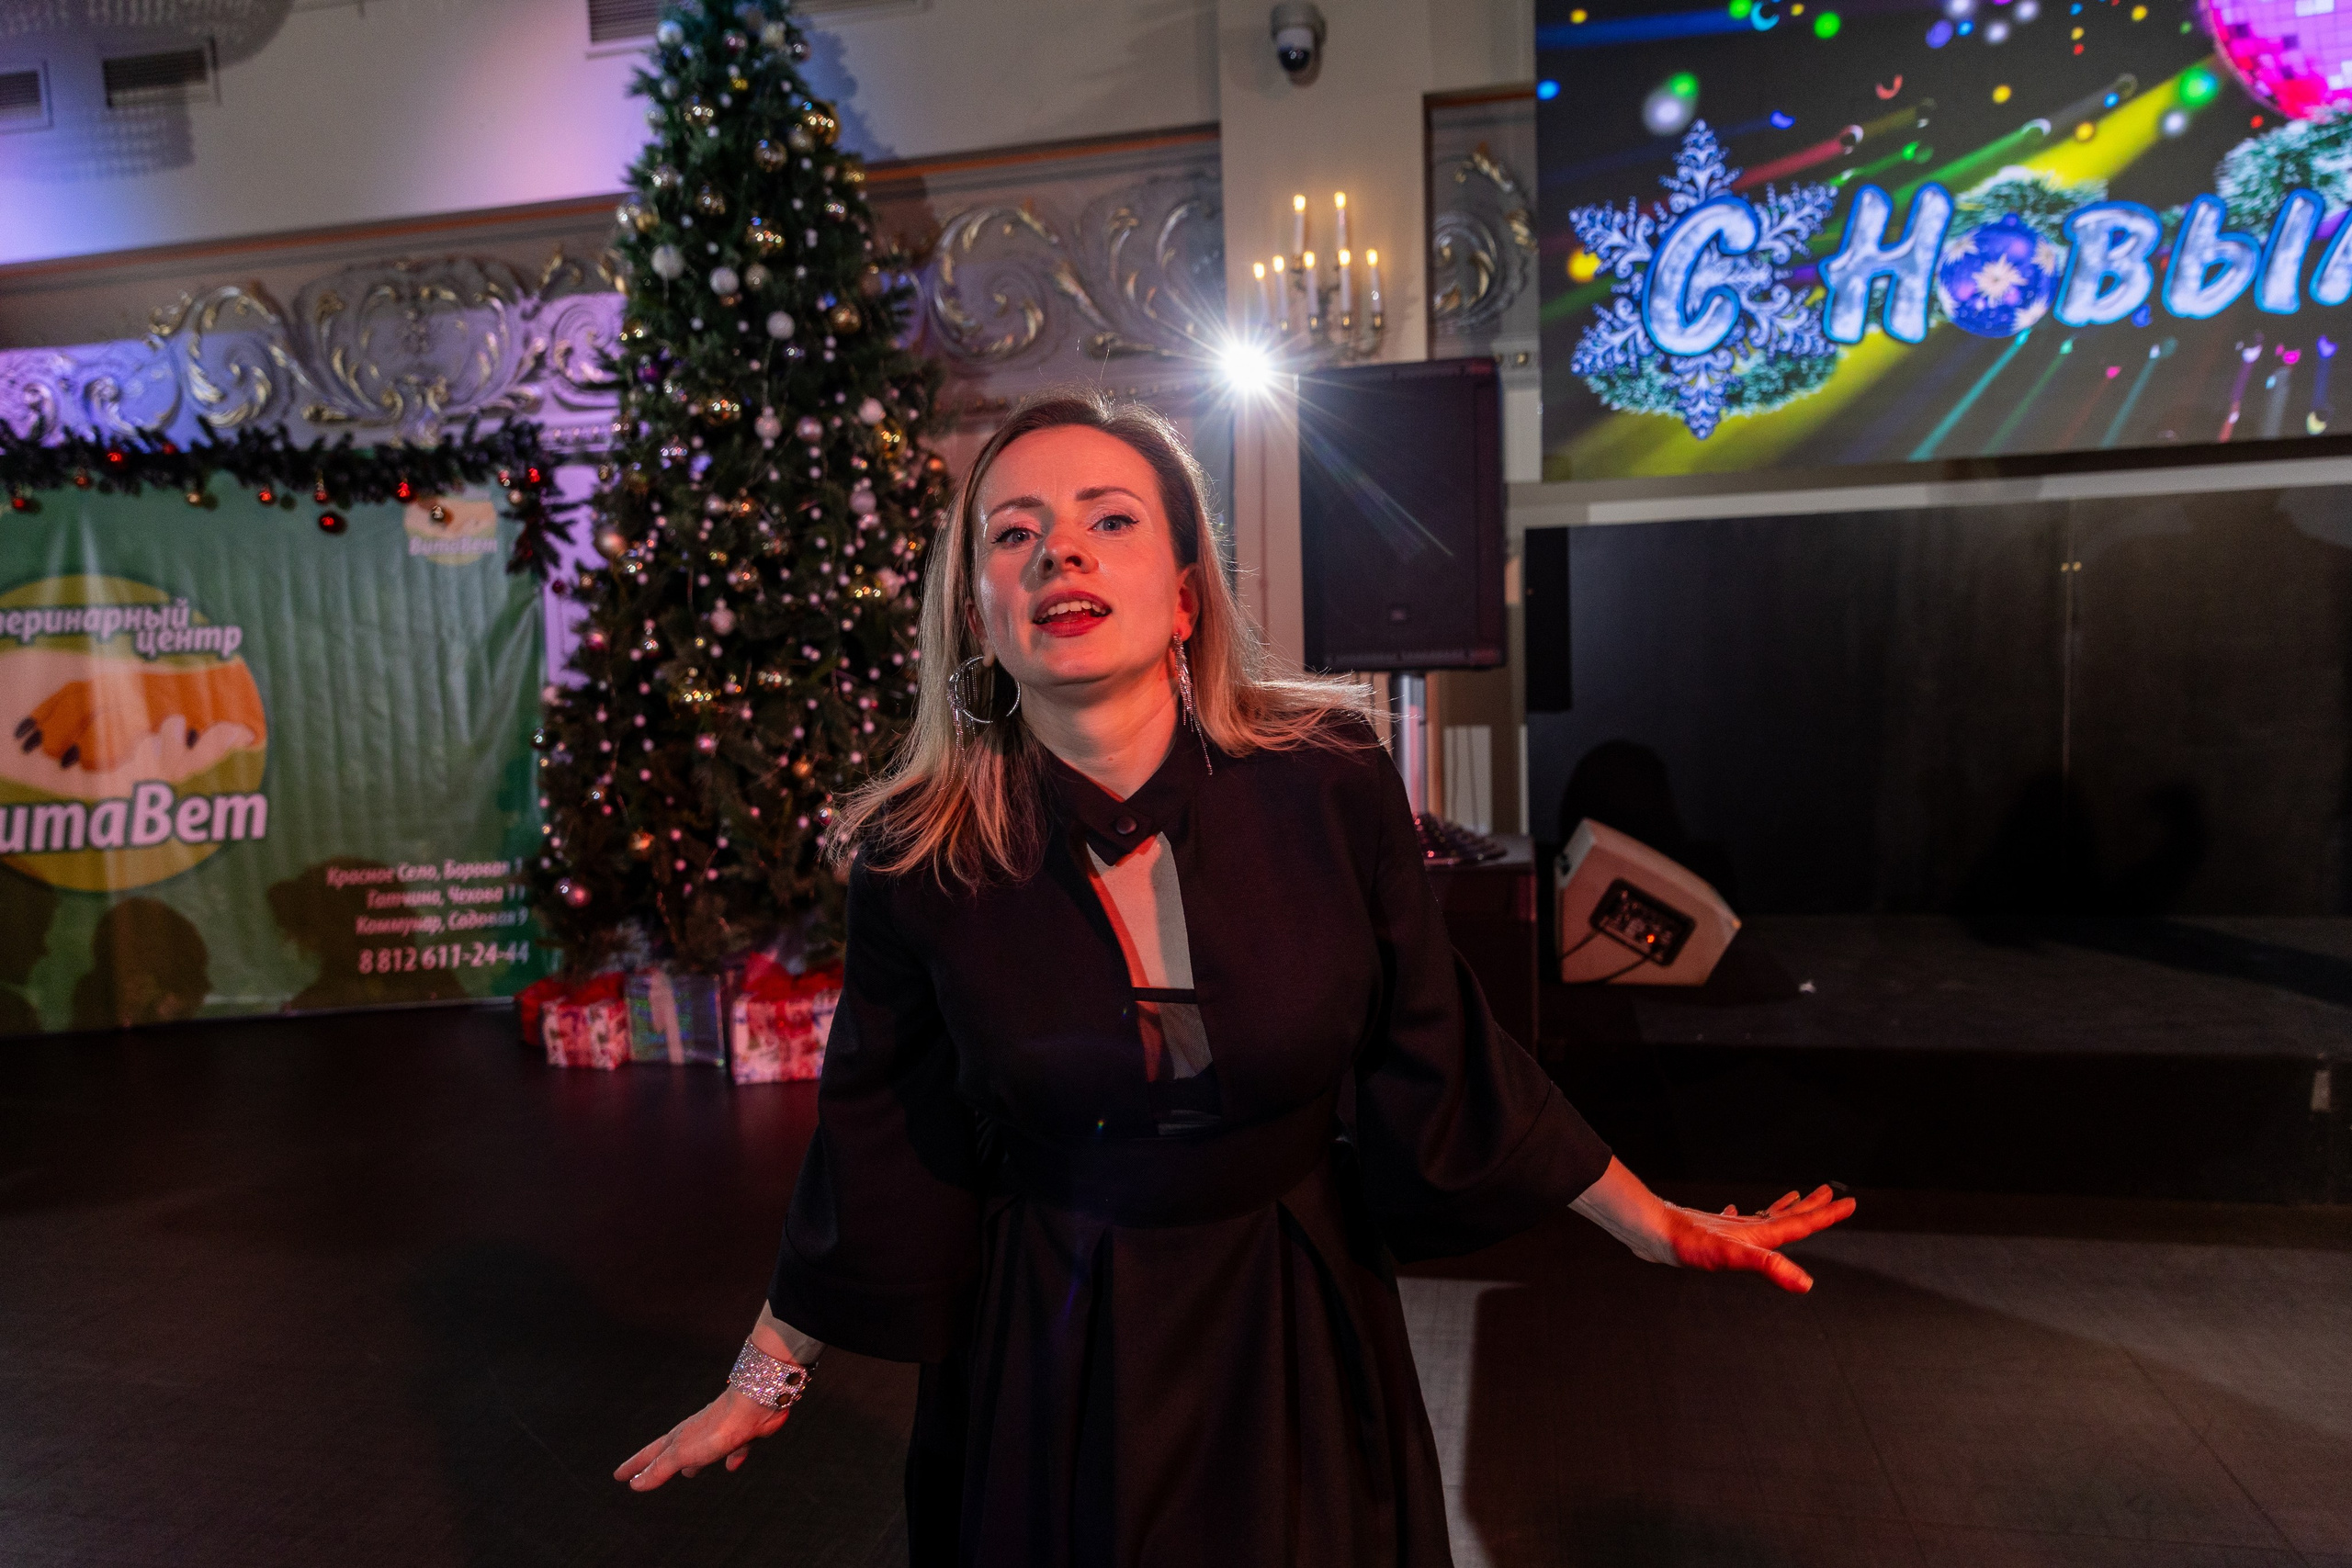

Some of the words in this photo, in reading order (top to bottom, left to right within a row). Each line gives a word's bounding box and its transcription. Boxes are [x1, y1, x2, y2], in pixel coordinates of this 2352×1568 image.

[1642, 195, 1760, 356] С
[0, 597, 190, 643] еринарный
[137, 625, 243, 658] центр
[421, 940, 529, 969] 611-24-44
